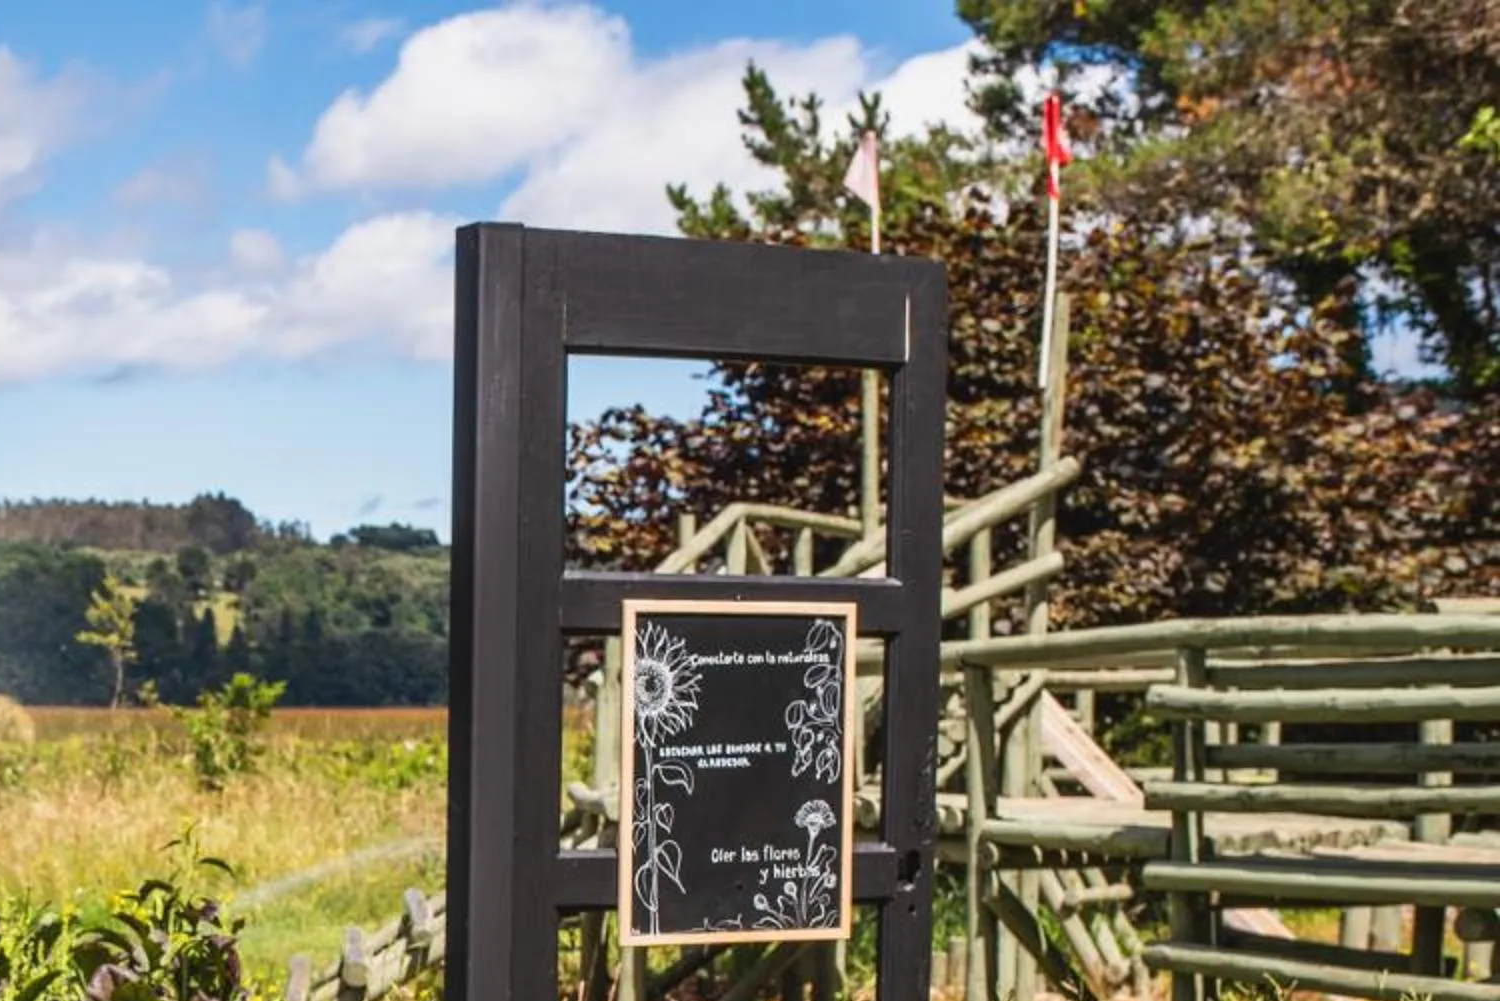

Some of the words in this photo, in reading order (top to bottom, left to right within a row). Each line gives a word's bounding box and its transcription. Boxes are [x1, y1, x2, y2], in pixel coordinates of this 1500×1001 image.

[746, 654, 765, 665] con
[765, 650, 777, 665] la
[710, 847, 737, 864] Oler
[741, 846, 760, 863] las
[763, 844, 802, 862] flores
[759, 868, 769, 885] y
